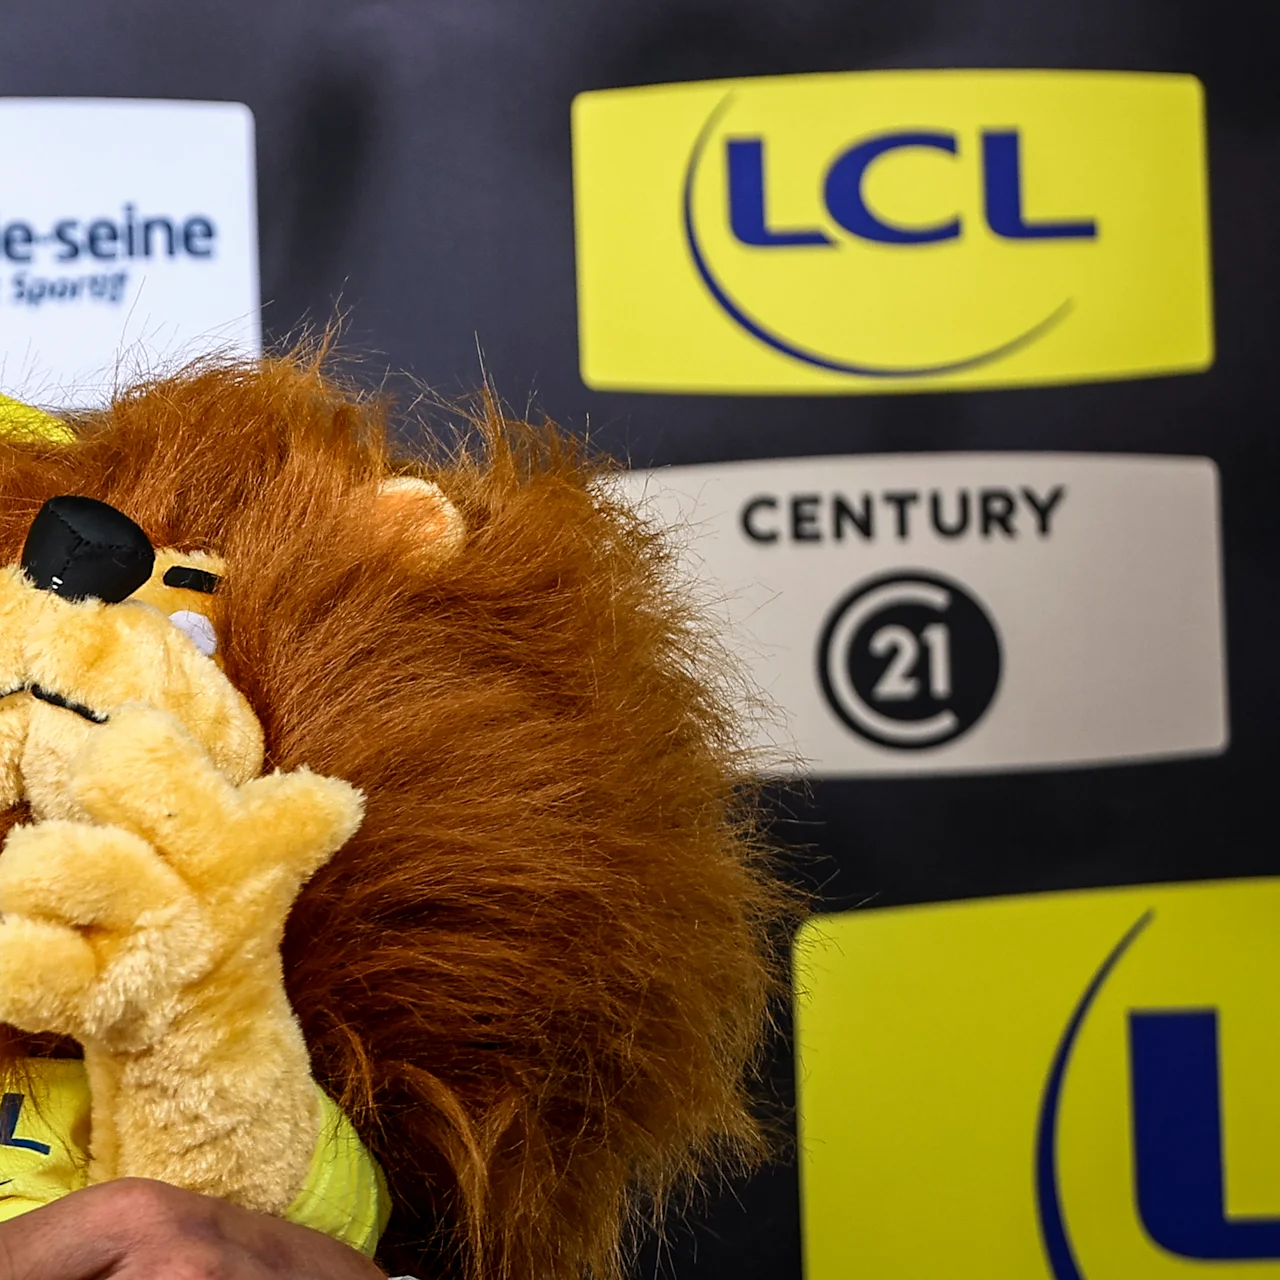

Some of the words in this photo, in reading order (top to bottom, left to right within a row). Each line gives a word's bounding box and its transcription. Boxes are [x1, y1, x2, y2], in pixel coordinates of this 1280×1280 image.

[724, 129, 1099, 248] LCL
[12, 270, 127, 306] Sportif
[739, 486, 1066, 546] CENTURY
